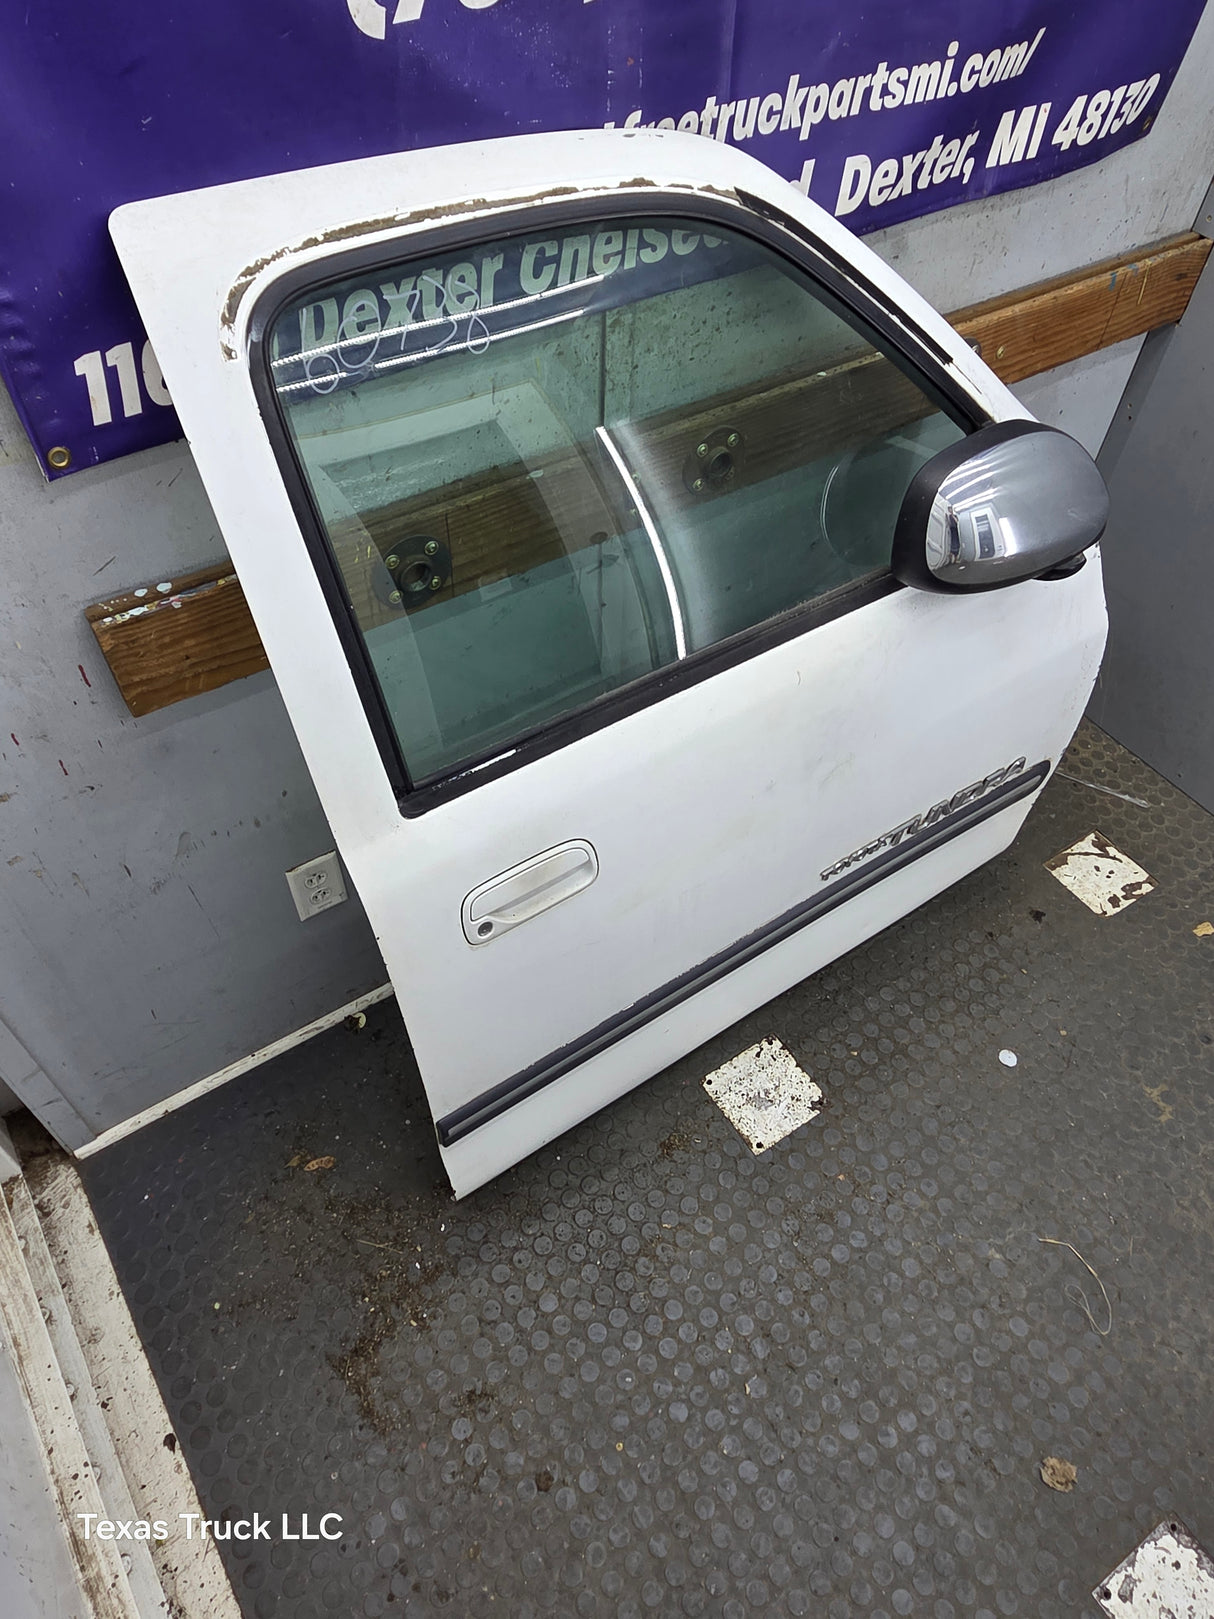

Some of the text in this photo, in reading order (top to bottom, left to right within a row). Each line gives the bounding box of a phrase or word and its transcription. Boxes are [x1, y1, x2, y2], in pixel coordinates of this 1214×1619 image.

[603, 26, 1047, 143] etruckpartsmi.com/
[834, 130, 980, 217] Dexter,
[986, 102, 1051, 168] MI
[1052, 73, 1160, 151] 48130
